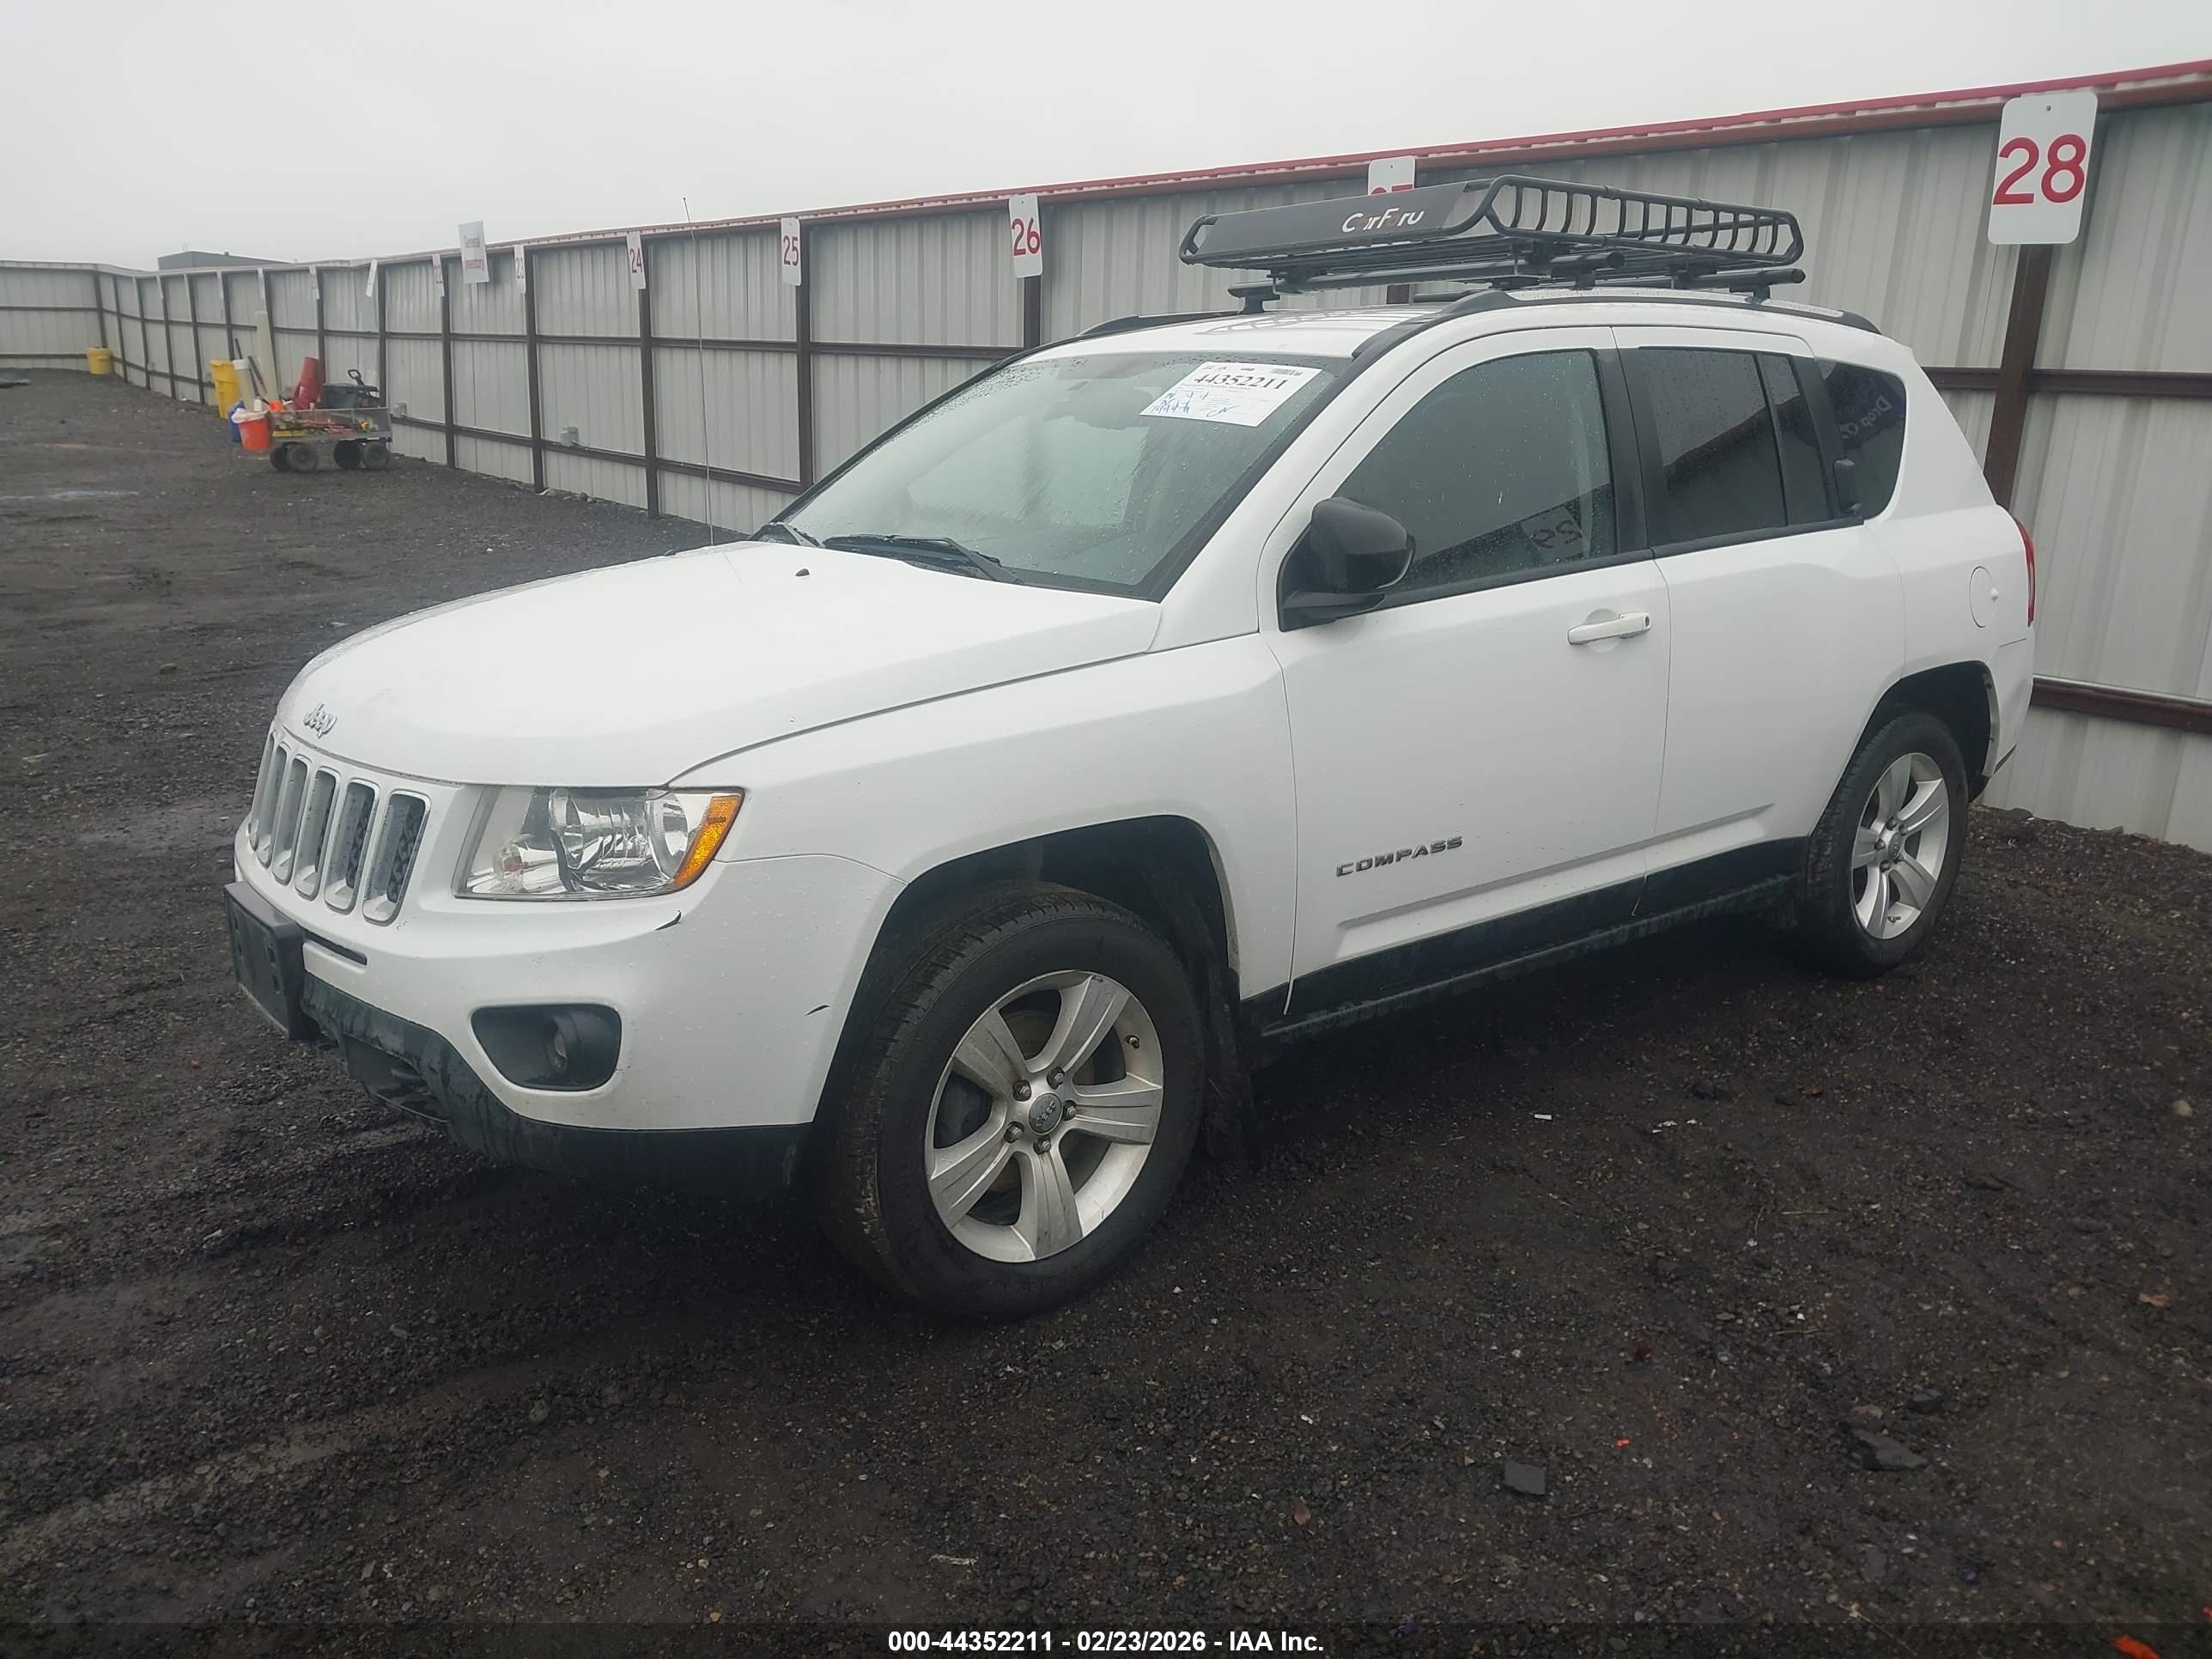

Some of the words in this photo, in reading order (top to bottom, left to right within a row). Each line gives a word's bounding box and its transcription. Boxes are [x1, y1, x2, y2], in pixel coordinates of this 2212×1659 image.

[1992, 133, 2087, 205] 28
[782, 234, 799, 266] 25
[1012, 217, 1041, 256] 26
[629, 247, 643, 274] 24
[1193, 374, 1289, 390] 44352211
[303, 703, 337, 739] Jeep
[1336, 836, 1463, 878] COMPASS
